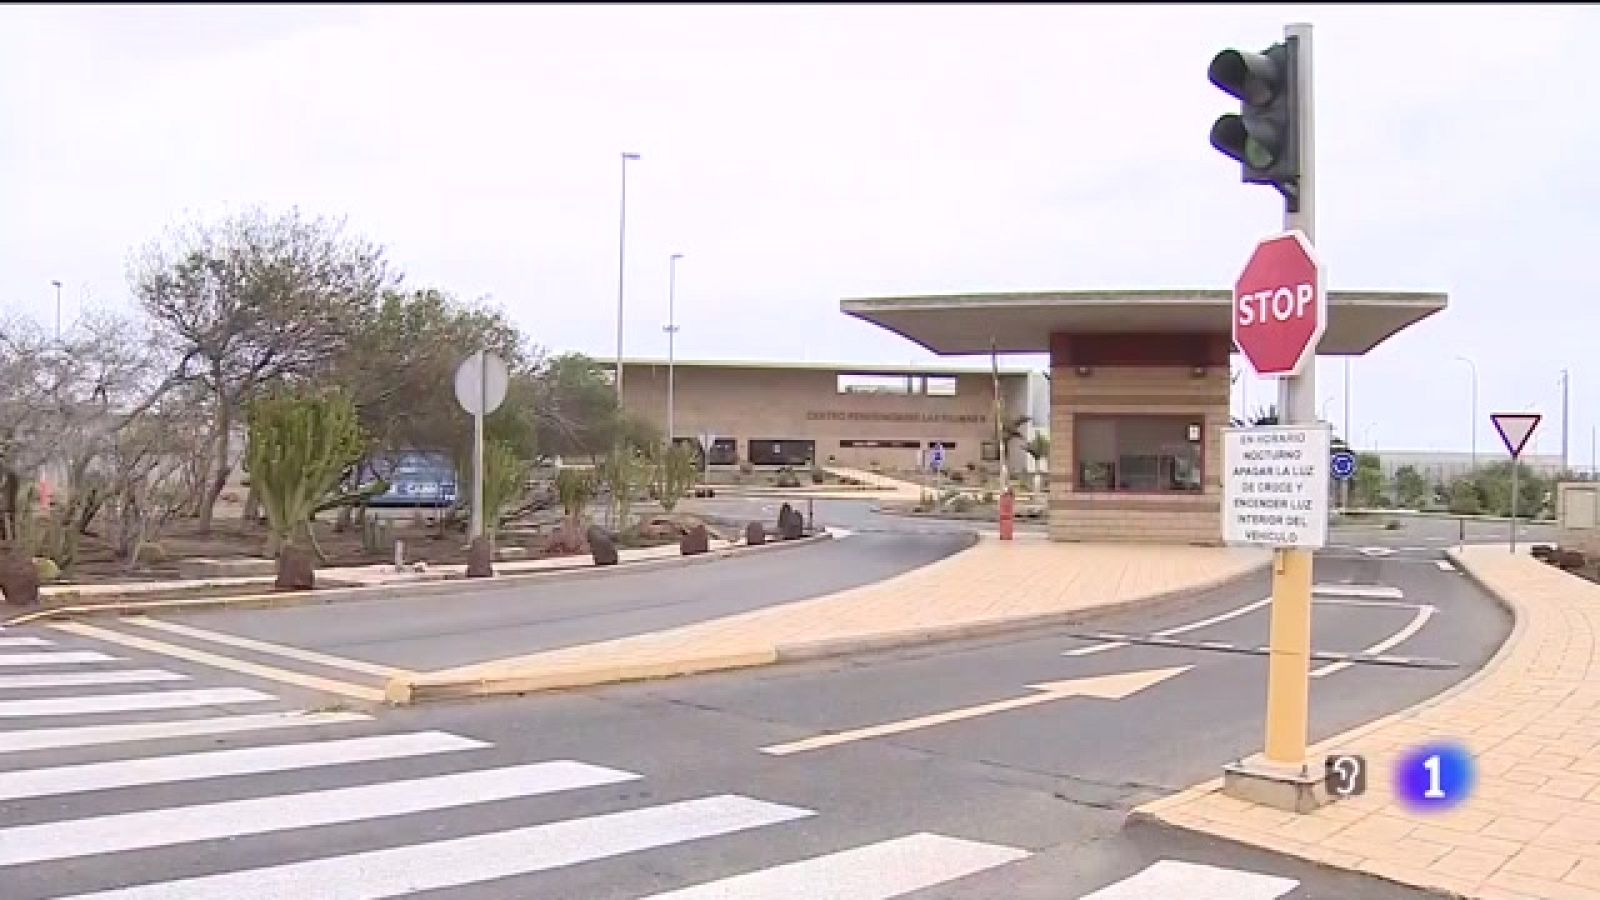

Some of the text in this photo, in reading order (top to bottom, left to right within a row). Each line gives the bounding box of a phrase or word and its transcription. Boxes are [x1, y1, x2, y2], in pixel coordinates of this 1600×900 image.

[1239, 284, 1313, 326] STOP
[1243, 449, 1302, 460] NOCTURNO
[1233, 465, 1315, 476] APAGAR LA LUZ
[1242, 482, 1303, 493] DE CRUCE Y
[1234, 498, 1312, 511] ENCENDER LUZ
[1237, 514, 1308, 527] INTERIOR DEL
